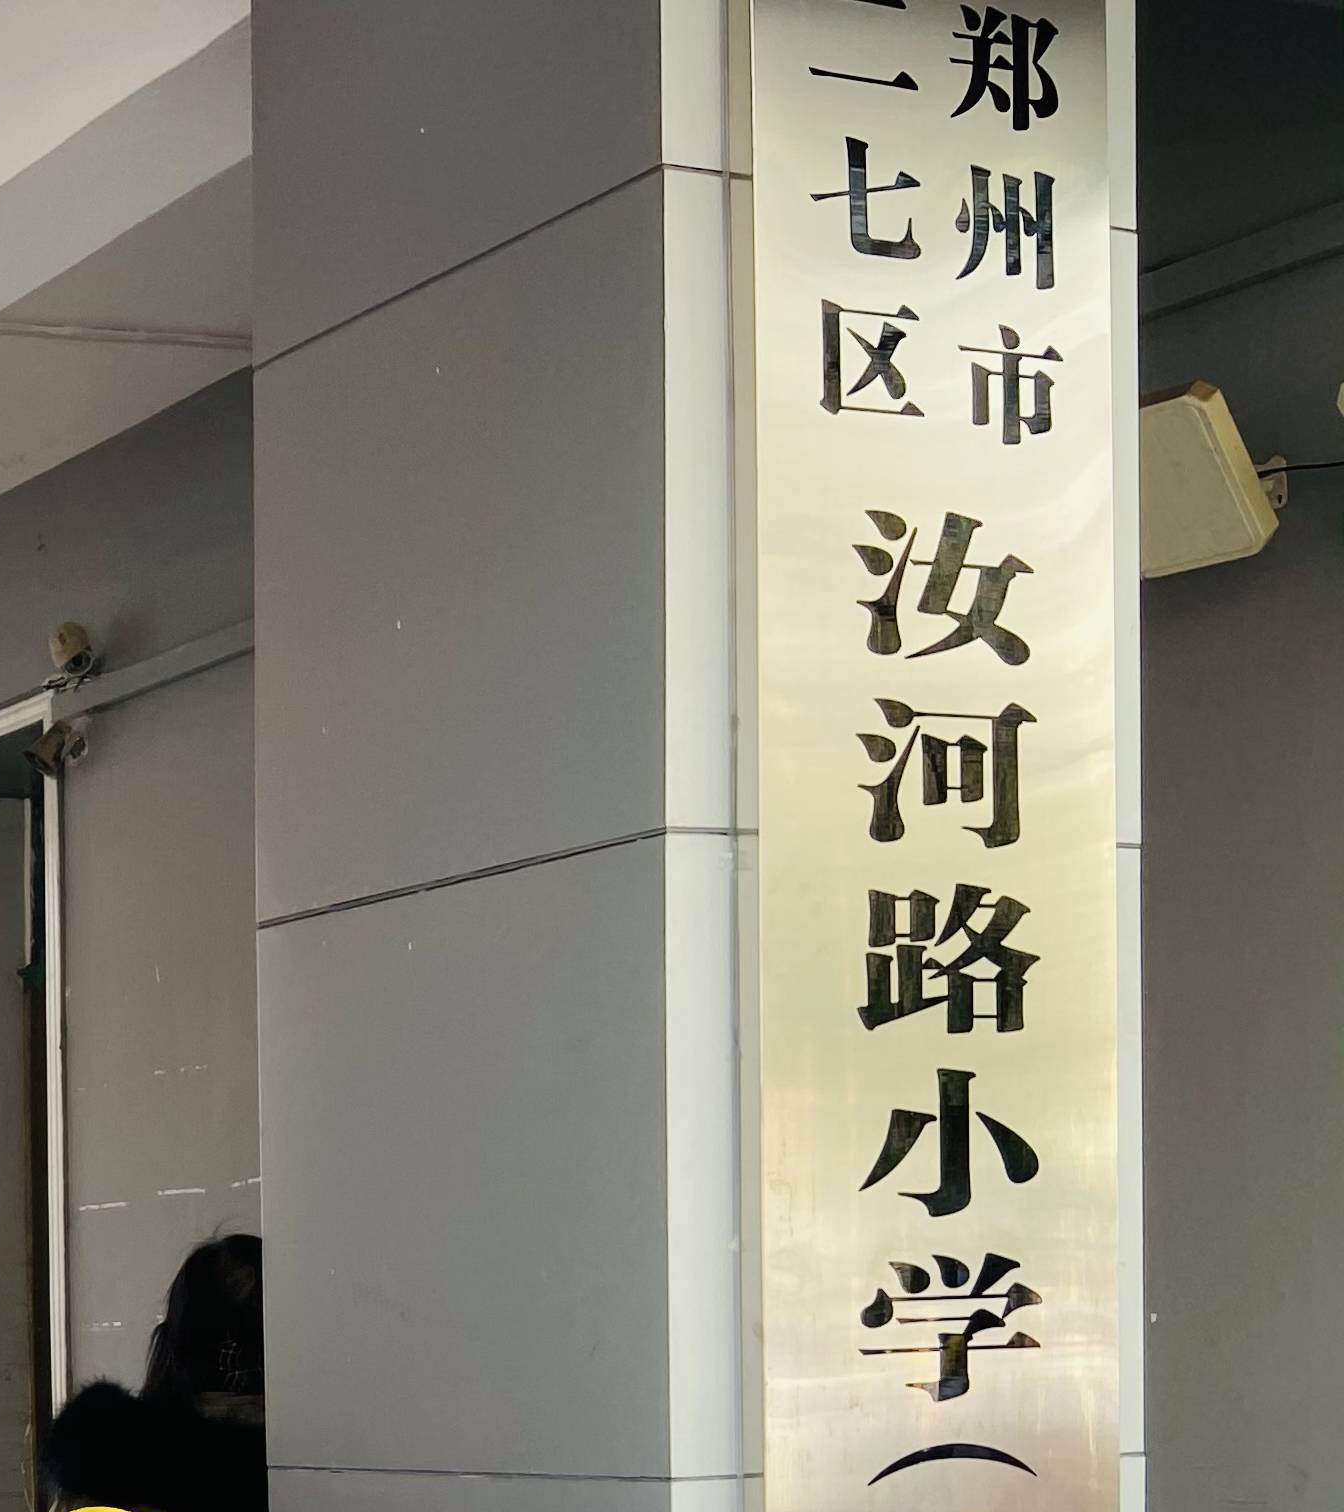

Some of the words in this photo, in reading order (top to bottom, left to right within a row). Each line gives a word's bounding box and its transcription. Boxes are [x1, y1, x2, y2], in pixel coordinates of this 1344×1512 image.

[808, 0, 924, 417] 二七区
[948, 4, 1063, 444] 郑州市
